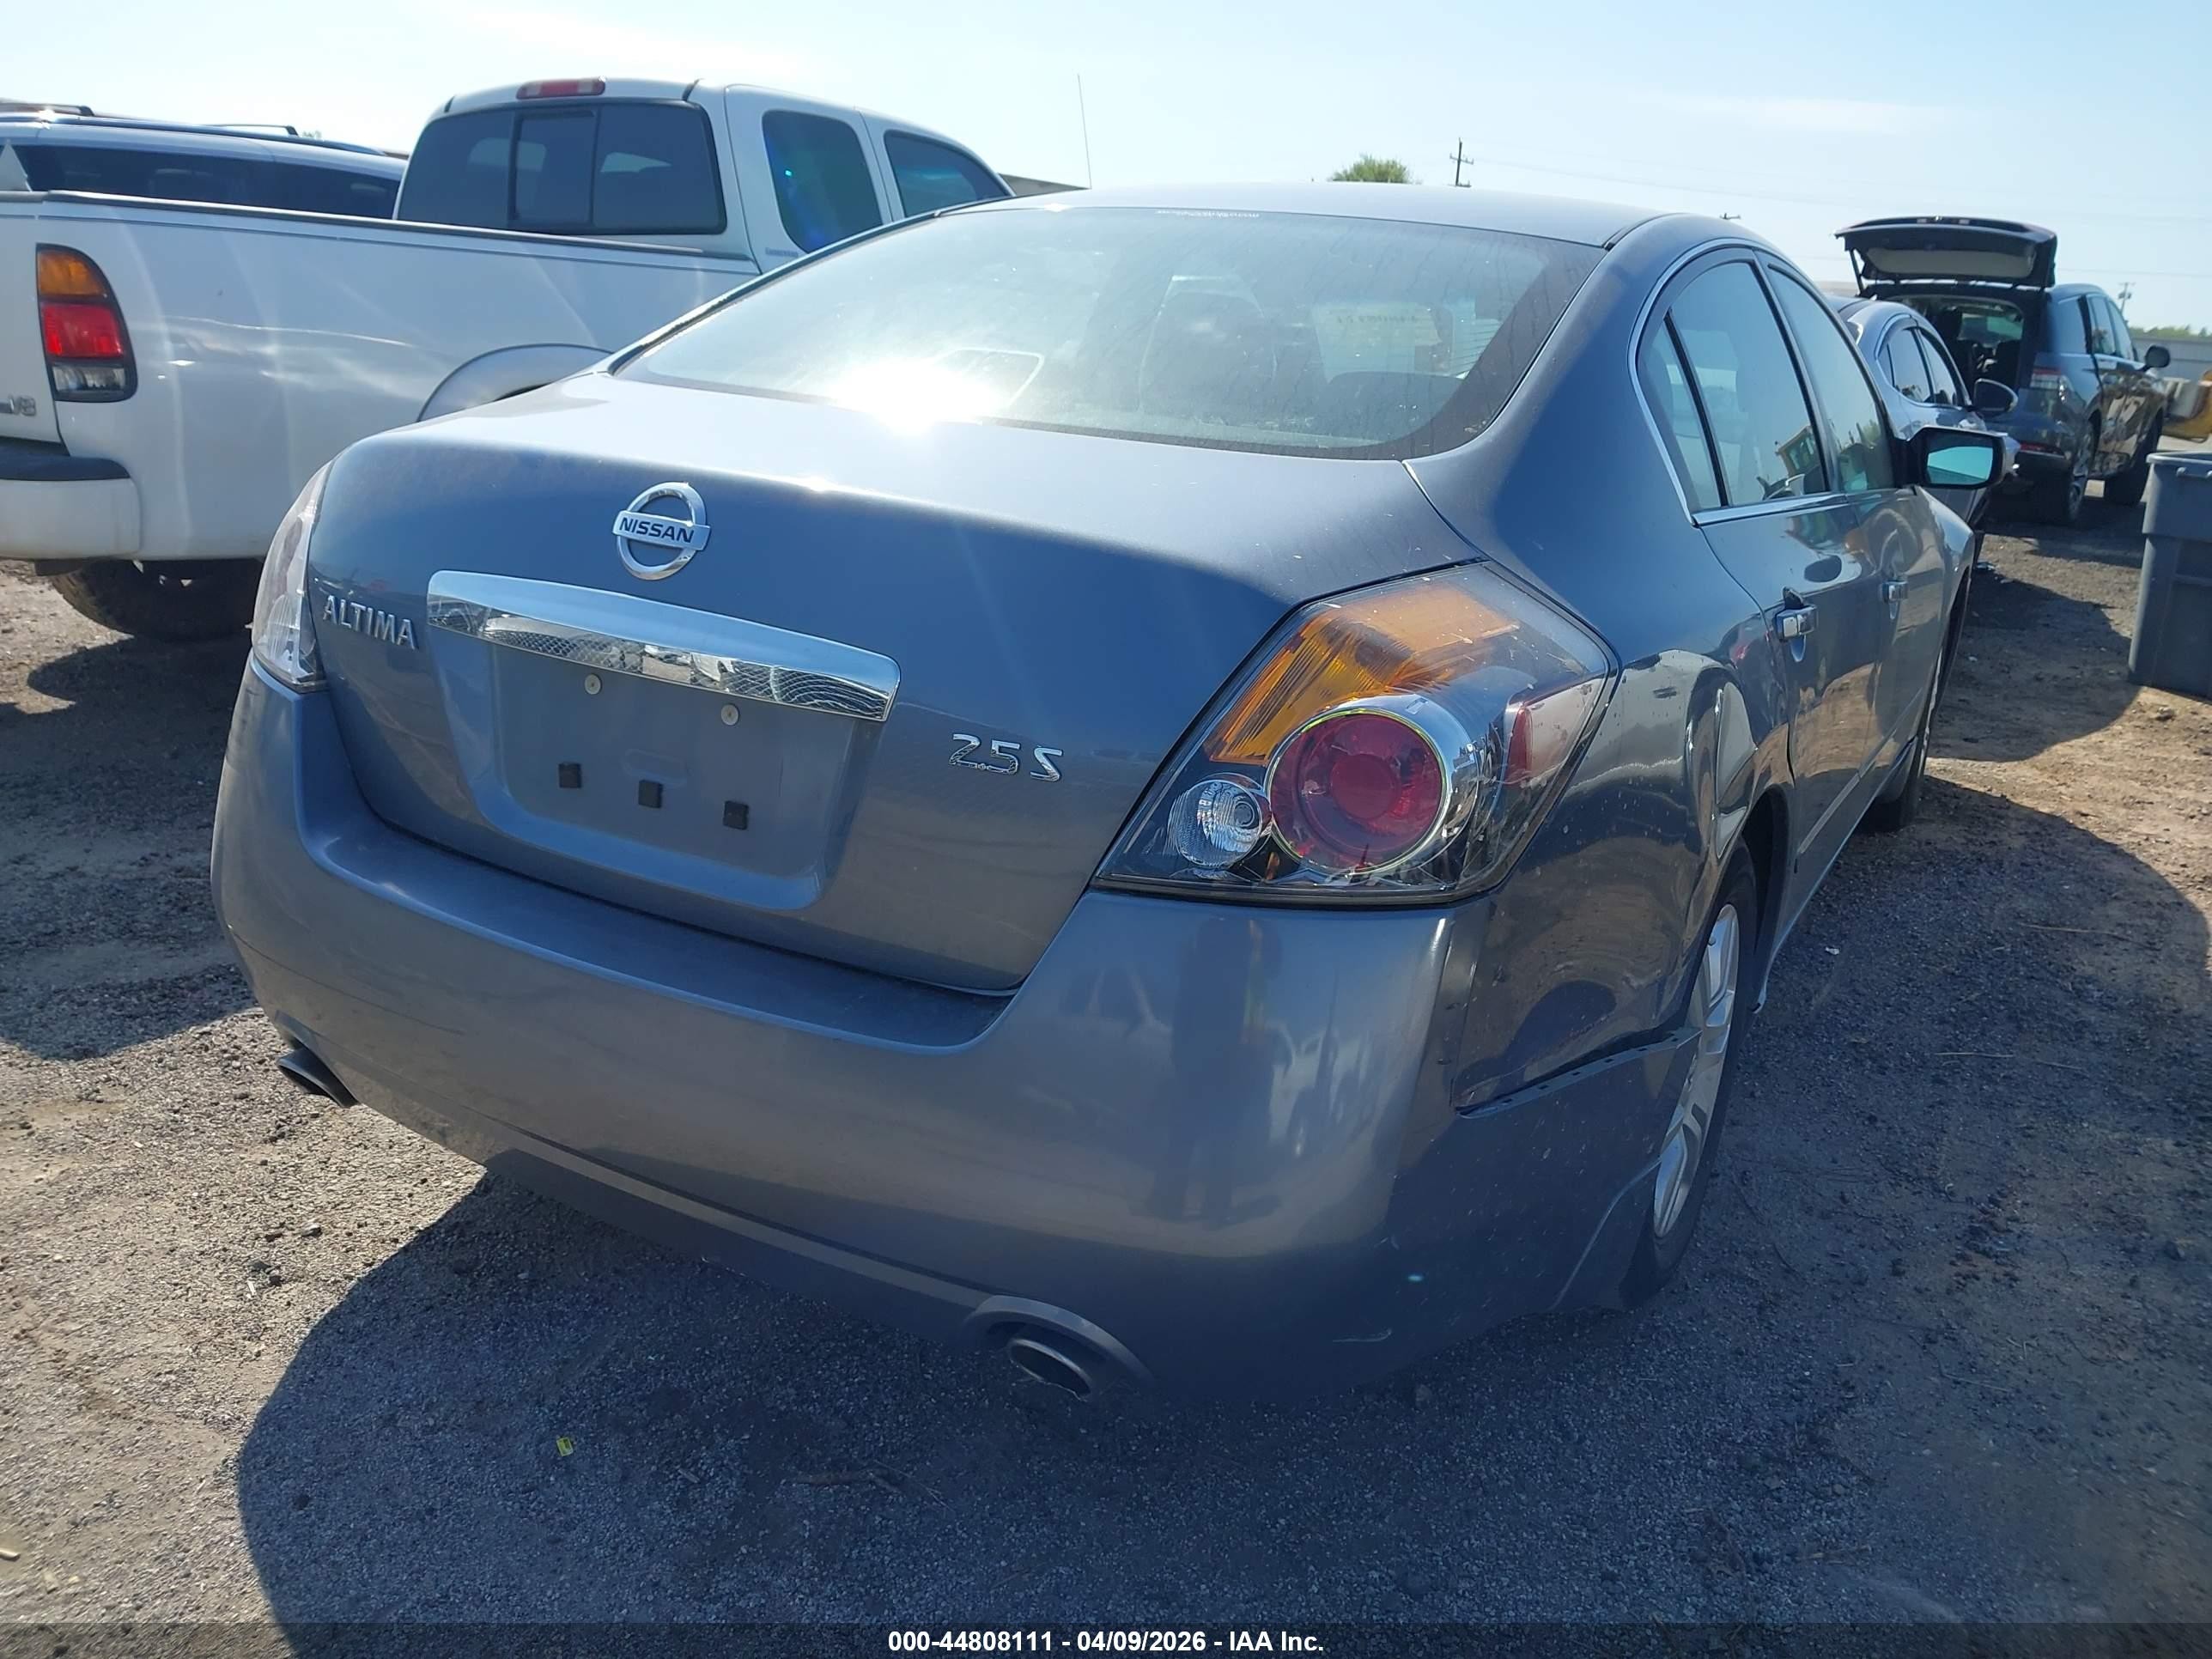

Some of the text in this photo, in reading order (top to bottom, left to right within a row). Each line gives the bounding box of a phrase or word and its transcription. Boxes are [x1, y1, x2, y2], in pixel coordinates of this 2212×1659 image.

[619, 517, 695, 544] NISSAN
[323, 594, 416, 650] ALTIMA
[948, 733, 1063, 782] 2.5 S
